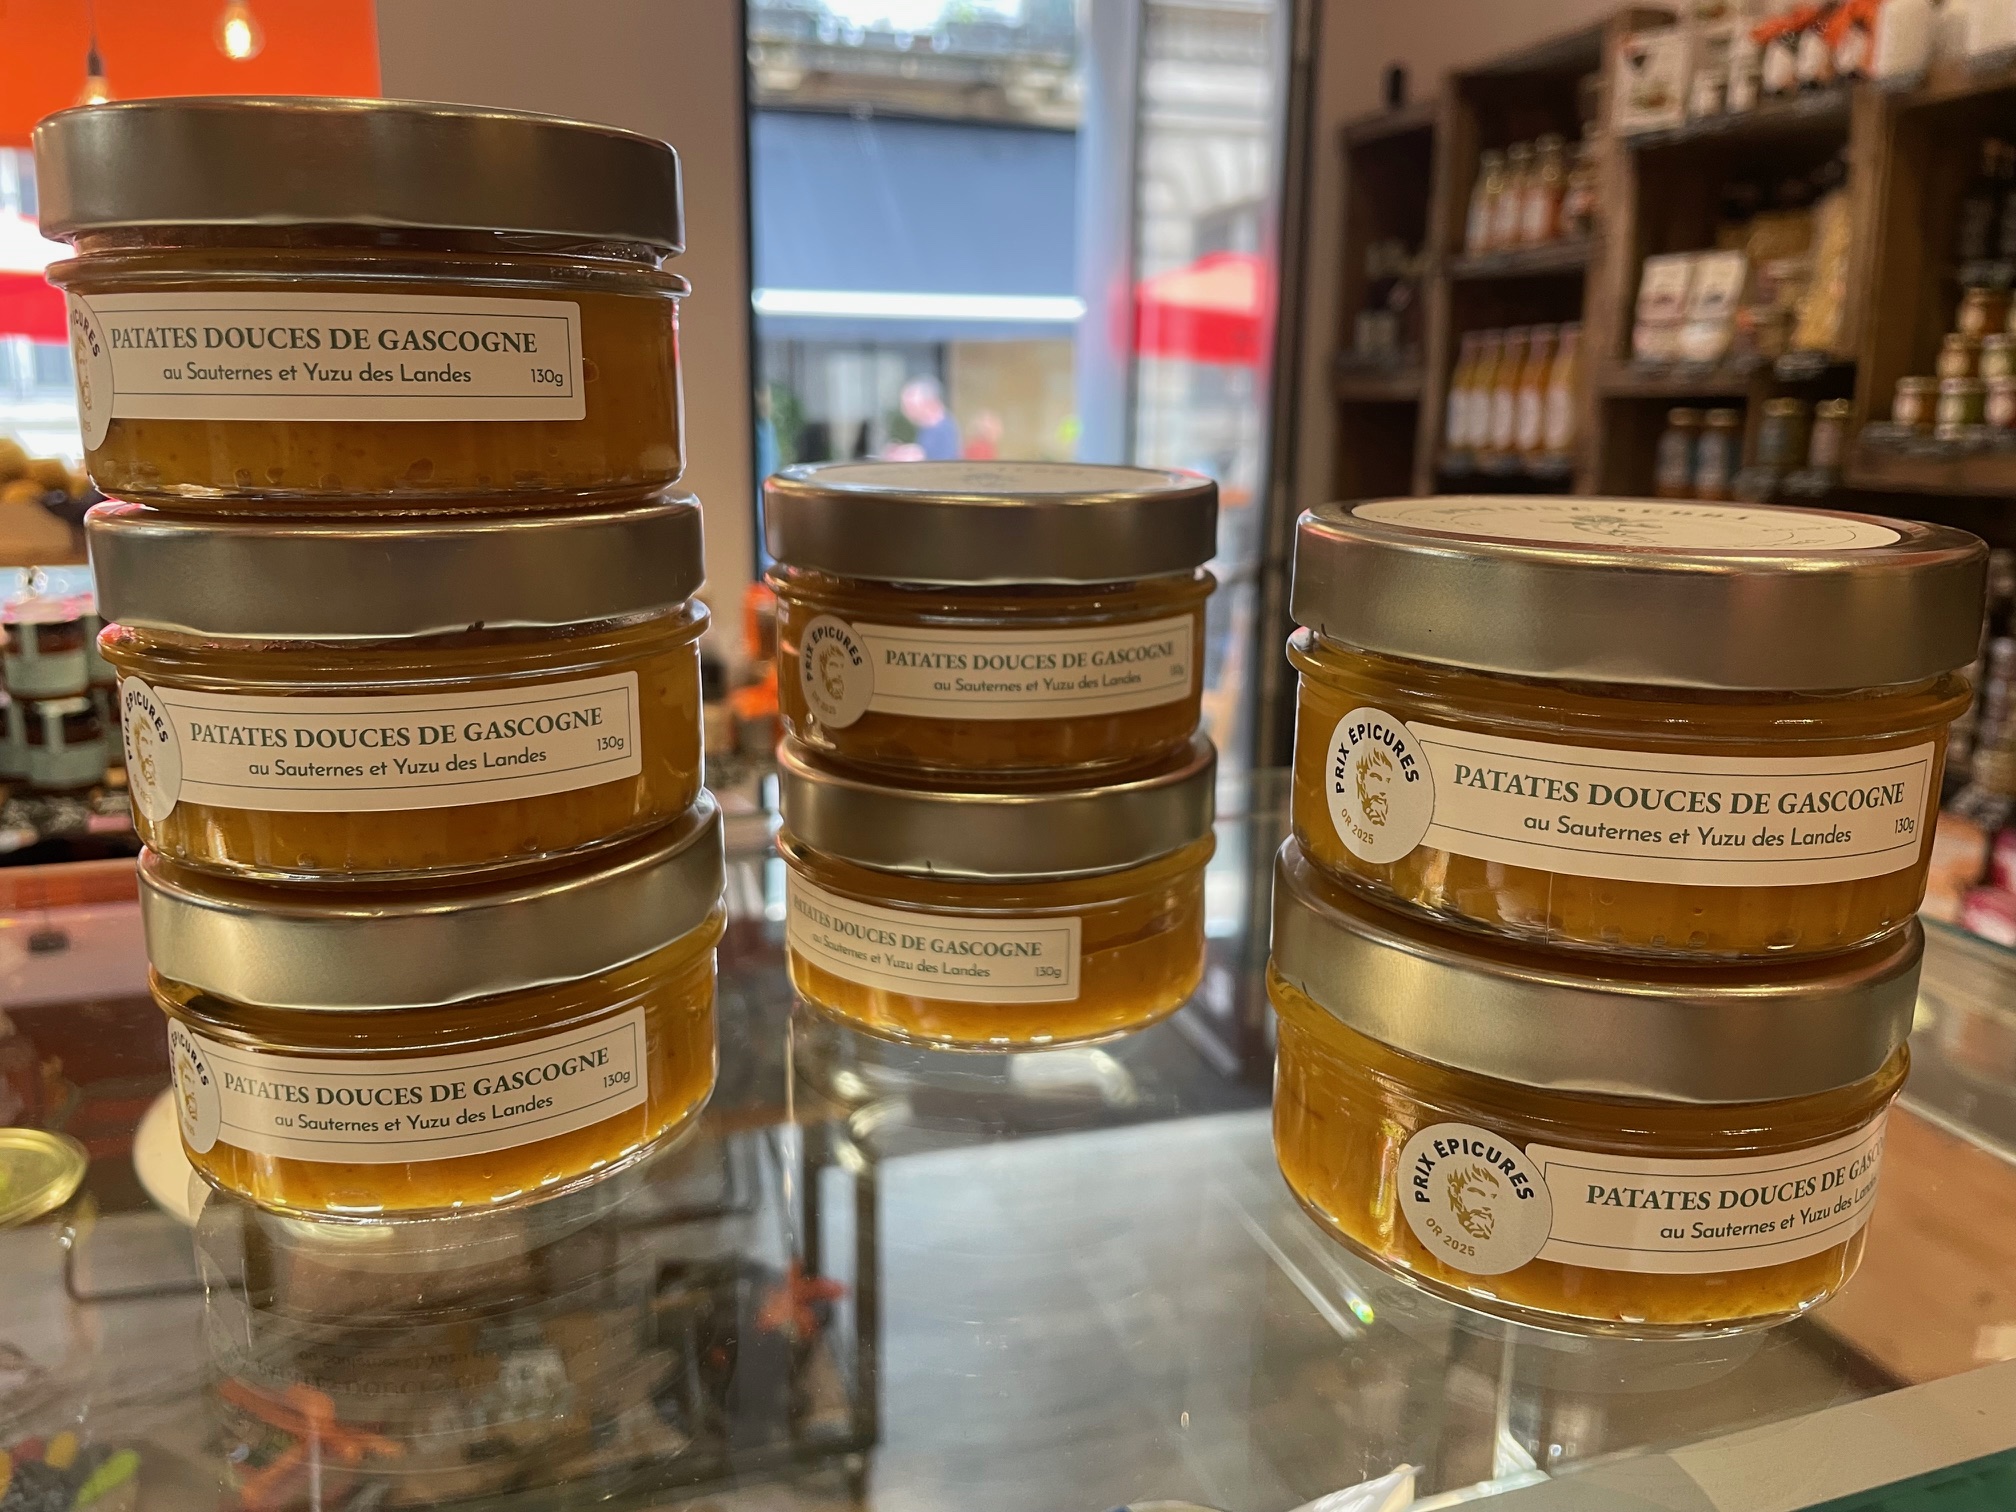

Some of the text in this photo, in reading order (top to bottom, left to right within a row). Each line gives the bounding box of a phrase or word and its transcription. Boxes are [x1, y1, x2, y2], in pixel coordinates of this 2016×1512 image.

[112, 326, 538, 354] PATATES DOUCES DE GASCOGNE
[164, 362, 472, 384] au Sauternes et Yuzu des Landes
[531, 368, 564, 387] 130g
[886, 650, 967, 669] PATATES
[973, 654, 1056, 670] DOUCES
[1063, 652, 1087, 668] DE
[934, 670, 1142, 693] au Sauternes et Yuzu des Landes
[191, 707, 603, 750] PATATES DOUCES DE GASCOGNE
[597, 736, 624, 752] 130g
[249, 749, 547, 778] au Sauternes et Yuzu des Landes
[1335, 742, 1350, 793] PRIX
[1454, 764, 1905, 816] PATATES DOUCES DE GASCOGNE
[1341, 808, 1374, 845] OR 2025
[1524, 815, 1852, 847] au Sauternes et Yuzu des Landes
[1894, 817, 1915, 835] 130g
[833, 917, 897, 946] DOUCES
[901, 934, 926, 951] DE
[930, 938, 1042, 957] GASCOGNE
[870, 953, 881, 963] et
[885, 953, 913, 970] Yuzu
[917, 958, 938, 974] des
[943, 961, 991, 977] Landes
[1035, 966, 1062, 979] 130g
[223, 1047, 610, 1106] PATATES DOUCES DE GASCOGNE
[603, 1070, 631, 1089] 130g
[275, 1095, 553, 1132] au Sauternes et Yuzu des Landes
[1413, 1152, 1436, 1203] PRIX
[1586, 1184, 1711, 1212] PATATES
[1717, 1176, 1817, 1211] DOUCES
[1821, 1166, 1846, 1192] DE
[1660, 1226, 1685, 1240] au
[1690, 1217, 1776, 1240] Sauternes
[1780, 1214, 1796, 1231] et
[1799, 1207, 1831, 1225] Yuzu
[1834, 1195, 1852, 1214] des
[1426, 1218, 1475, 1257] OR 2025
